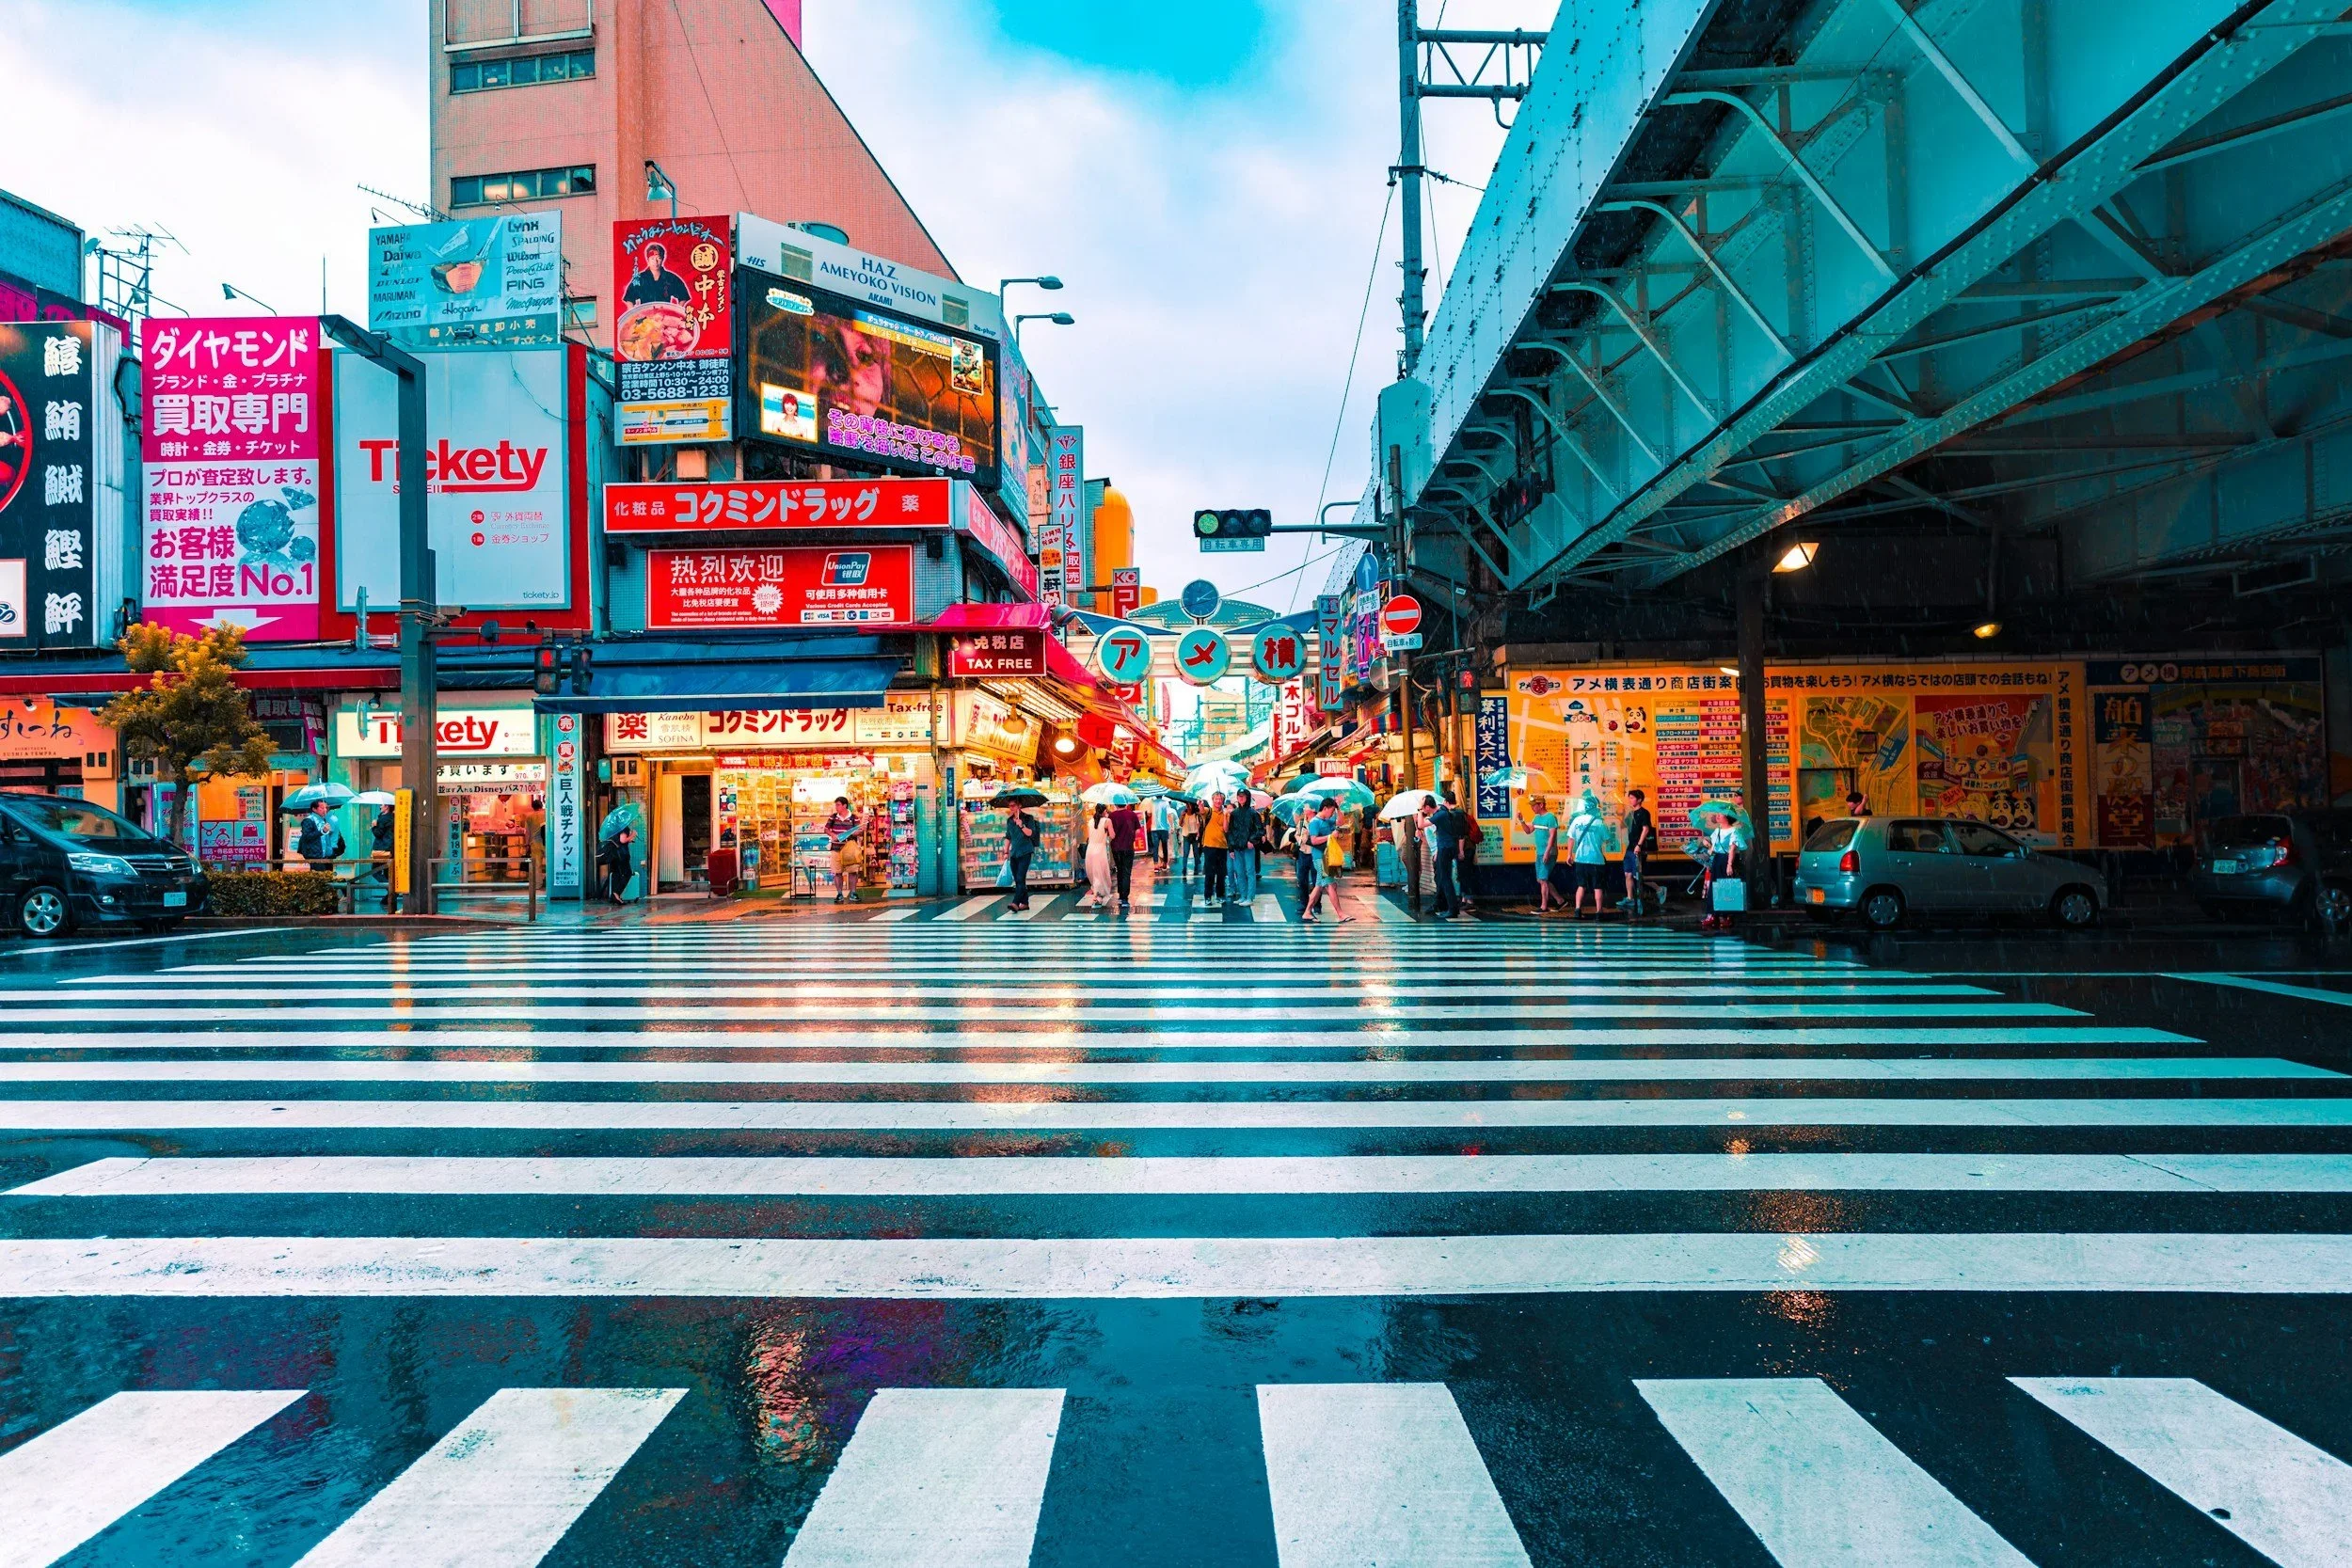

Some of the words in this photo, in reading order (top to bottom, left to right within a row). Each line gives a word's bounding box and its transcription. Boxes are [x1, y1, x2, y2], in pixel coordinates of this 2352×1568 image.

[375, 232, 411, 245] YAMAHA
[512, 232, 554, 247] SPALDING
[383, 250, 421, 262] Daiwa
[506, 251, 540, 261] Wilson
[507, 277, 545, 292] PING
[820, 261, 887, 290] AMEYOKO
[891, 282, 936, 306] VISION
[373, 291, 416, 302] MARUMAN
[694, 274, 716, 330] 中本
[868, 293, 892, 307] AKAMI
[442, 303, 482, 320] Hogan
[151, 327, 309, 370] ダイヤモンド
[622, 360, 695, 373] 蒙古タンメン中本
[699, 358, 728, 370] 御徒町
[152, 373, 307, 388] ブランド・金・プラチナ
[622, 385, 729, 401] 03-5688-1233
[152, 392, 309, 436] 買取専門
[829, 408, 961, 452] その背後に忍び寄る
[160, 440, 300, 457] 時計・金券・チケット
[359, 439, 548, 493] Tkety
[920, 446, 976, 473] この作品
[150, 468, 312, 487] プロが査定致します。
[150, 491, 254, 505] 業界トップクラスの
[675, 487, 880, 523] コクミンドラッグ
[902, 495, 919, 513] 薬
[1057, 454, 1077, 552] 銀座パリス
[614, 501, 665, 516] 化粧品
[151, 526, 234, 561] お客様
[492, 533, 549, 544] 金券ショップ
[1204, 539, 1261, 549] 自転車専用
[671, 554, 785, 584] 热烈欢迎
[828, 562, 866, 573] UnionPay
[151, 562, 312, 598] 満足度No.1
[805, 589, 835, 600] 可使用
[837, 588, 887, 599] 多种信用卡
[975, 635, 1025, 650] 免税店
[1387, 637, 1419, 648] 自転車を除く
[1110, 637, 1296, 670] アメ横
[1321, 618, 1342, 705] マルセル
[966, 658, 993, 669] TAX
[997, 658, 1033, 669] FREE
[2124, 666, 2176, 679] アメ横
[887, 703, 943, 712] Tax-free
[1933, 703, 2009, 724] アメ横表通りで
[658, 713, 694, 721] Kanebo
[708, 708, 849, 733] コクミンドラッグ
[372, 716, 499, 750] Tiety
[658, 734, 694, 743] SOFINA
[1957, 762, 2008, 772] アメ横
[2058, 671, 2074, 847] アメ横表通り商店街振興組合
[560, 779, 573, 870] 巨人戦チケット
